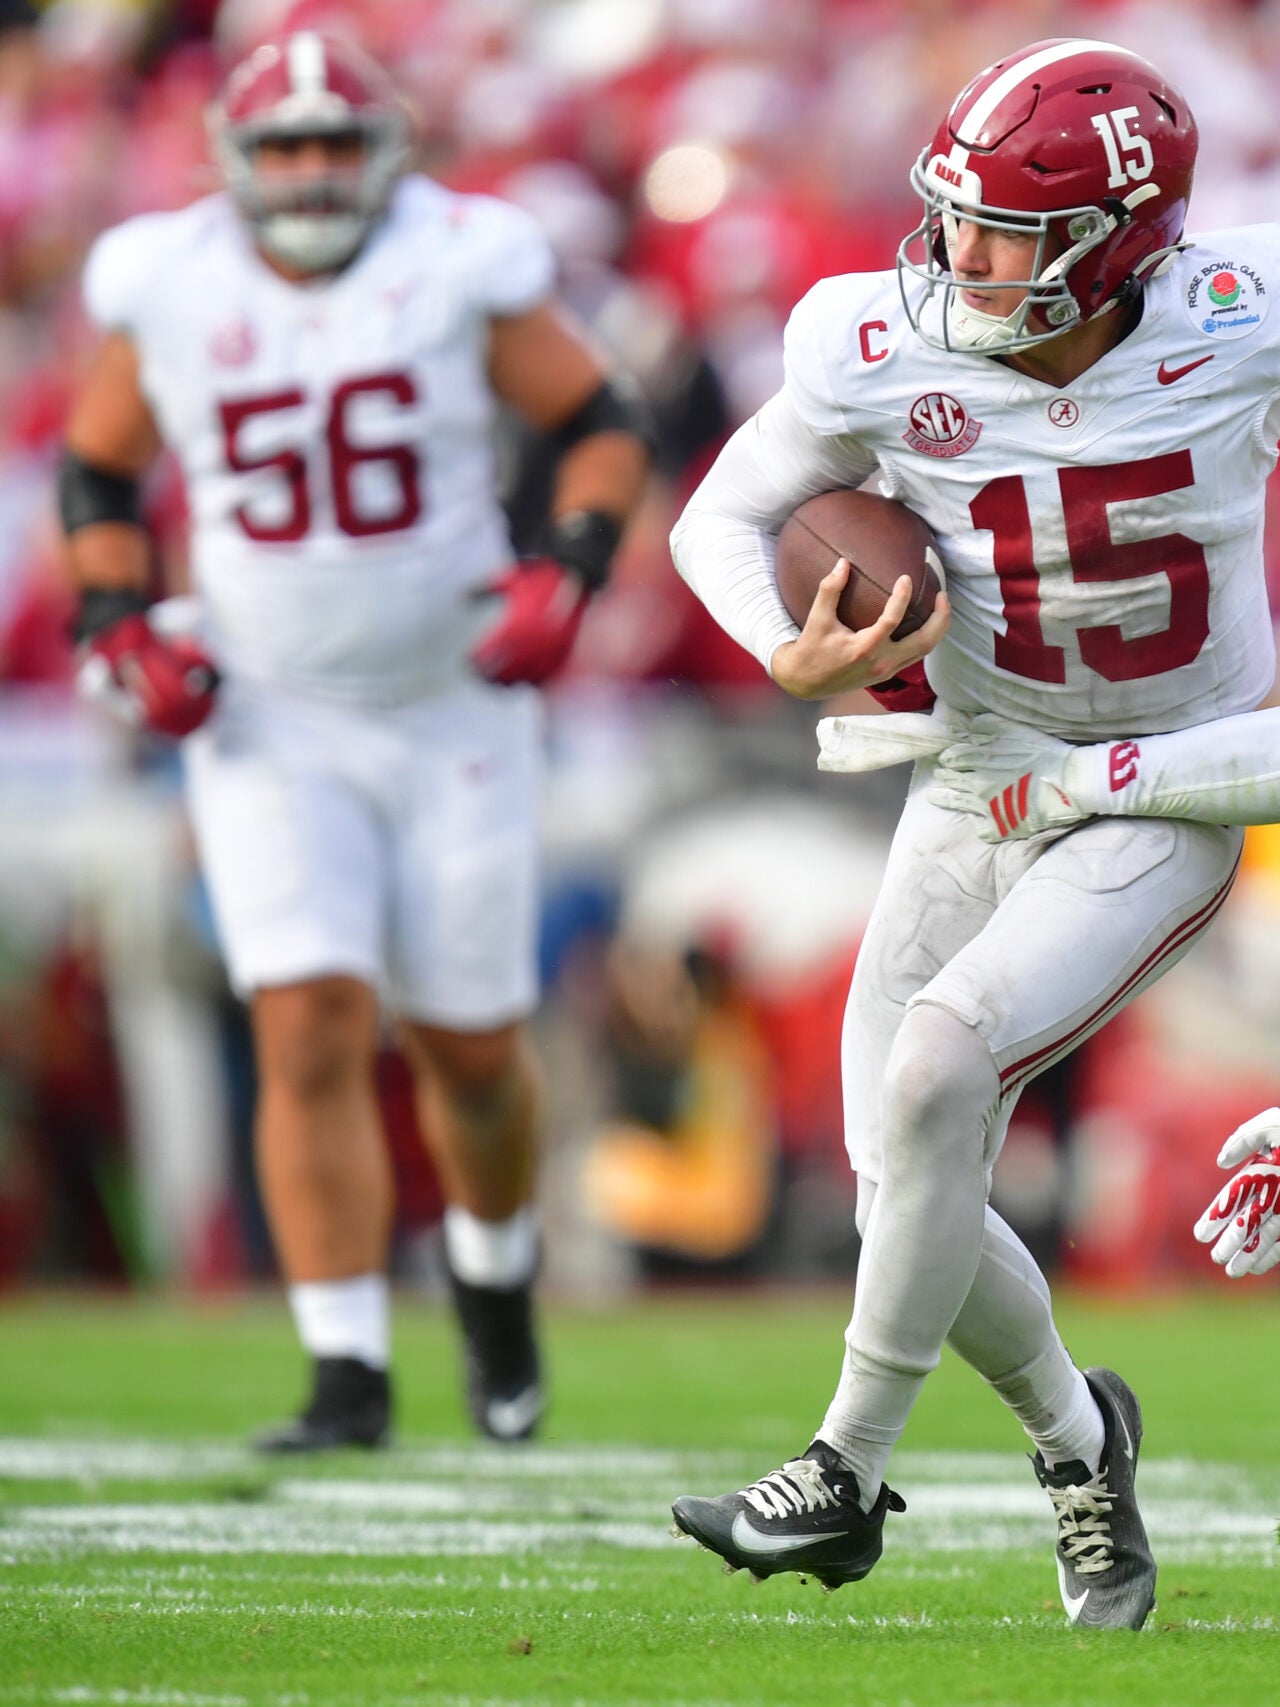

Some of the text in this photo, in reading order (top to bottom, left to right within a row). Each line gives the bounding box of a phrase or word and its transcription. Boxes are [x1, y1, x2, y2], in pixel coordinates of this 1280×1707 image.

[1090, 105, 1155, 189] 15
[935, 161, 963, 188] BAMA
[1187, 261, 1266, 308] ROSE BOWL GAME
[1211, 304, 1239, 317] presented
[1217, 314, 1260, 328] Prudential
[859, 320, 889, 363] C
[912, 394, 964, 440] SEC
[219, 373, 420, 543] 56
[915, 434, 975, 457] GRADUATE
[968, 448, 1211, 685] 15
